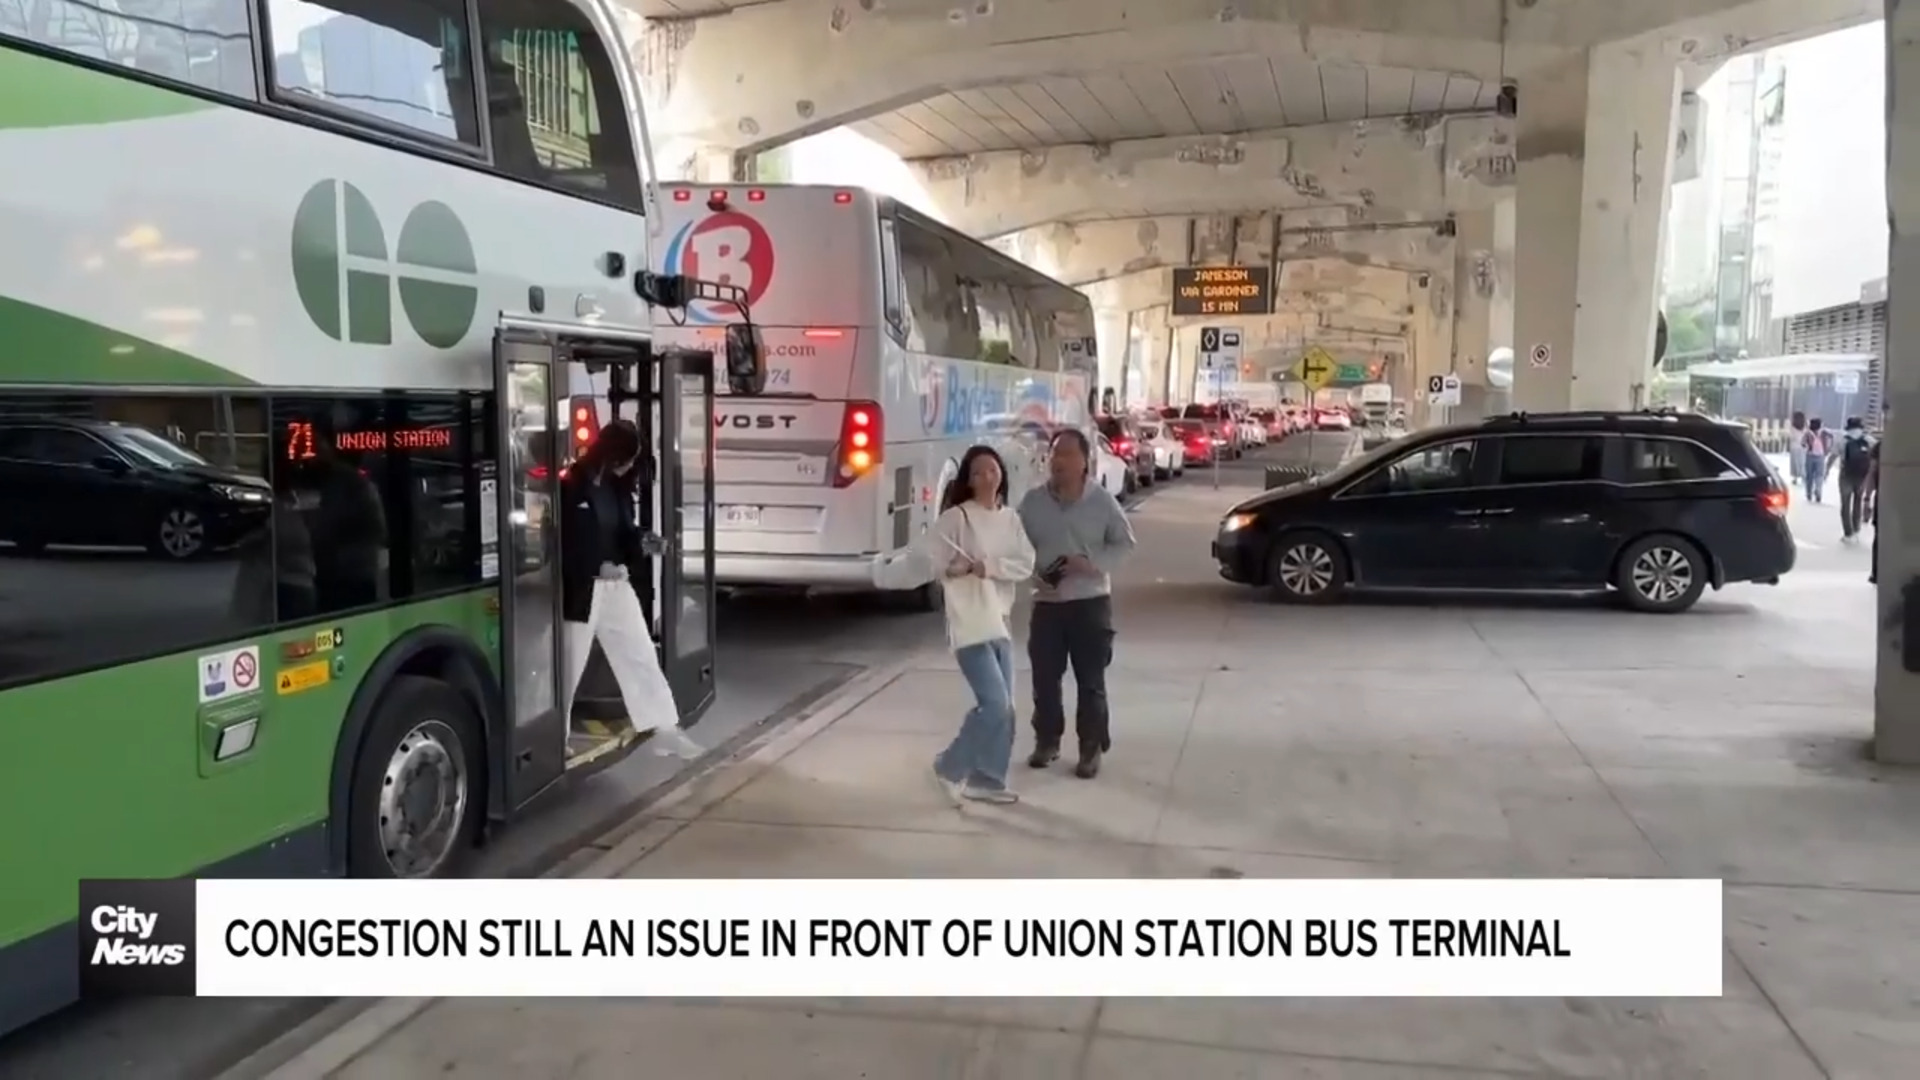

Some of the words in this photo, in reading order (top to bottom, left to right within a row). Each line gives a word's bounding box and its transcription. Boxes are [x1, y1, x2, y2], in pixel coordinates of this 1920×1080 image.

[291, 178, 478, 349] GO
[1194, 270, 1248, 281] JAMESON
[1181, 286, 1199, 297] VIA
[1203, 285, 1259, 297] GARDINER
[1202, 302, 1215, 313] 15
[1219, 301, 1239, 312] MIN
[287, 423, 316, 460] 71
[336, 432, 386, 450] UNION
[393, 429, 450, 448] STATION
